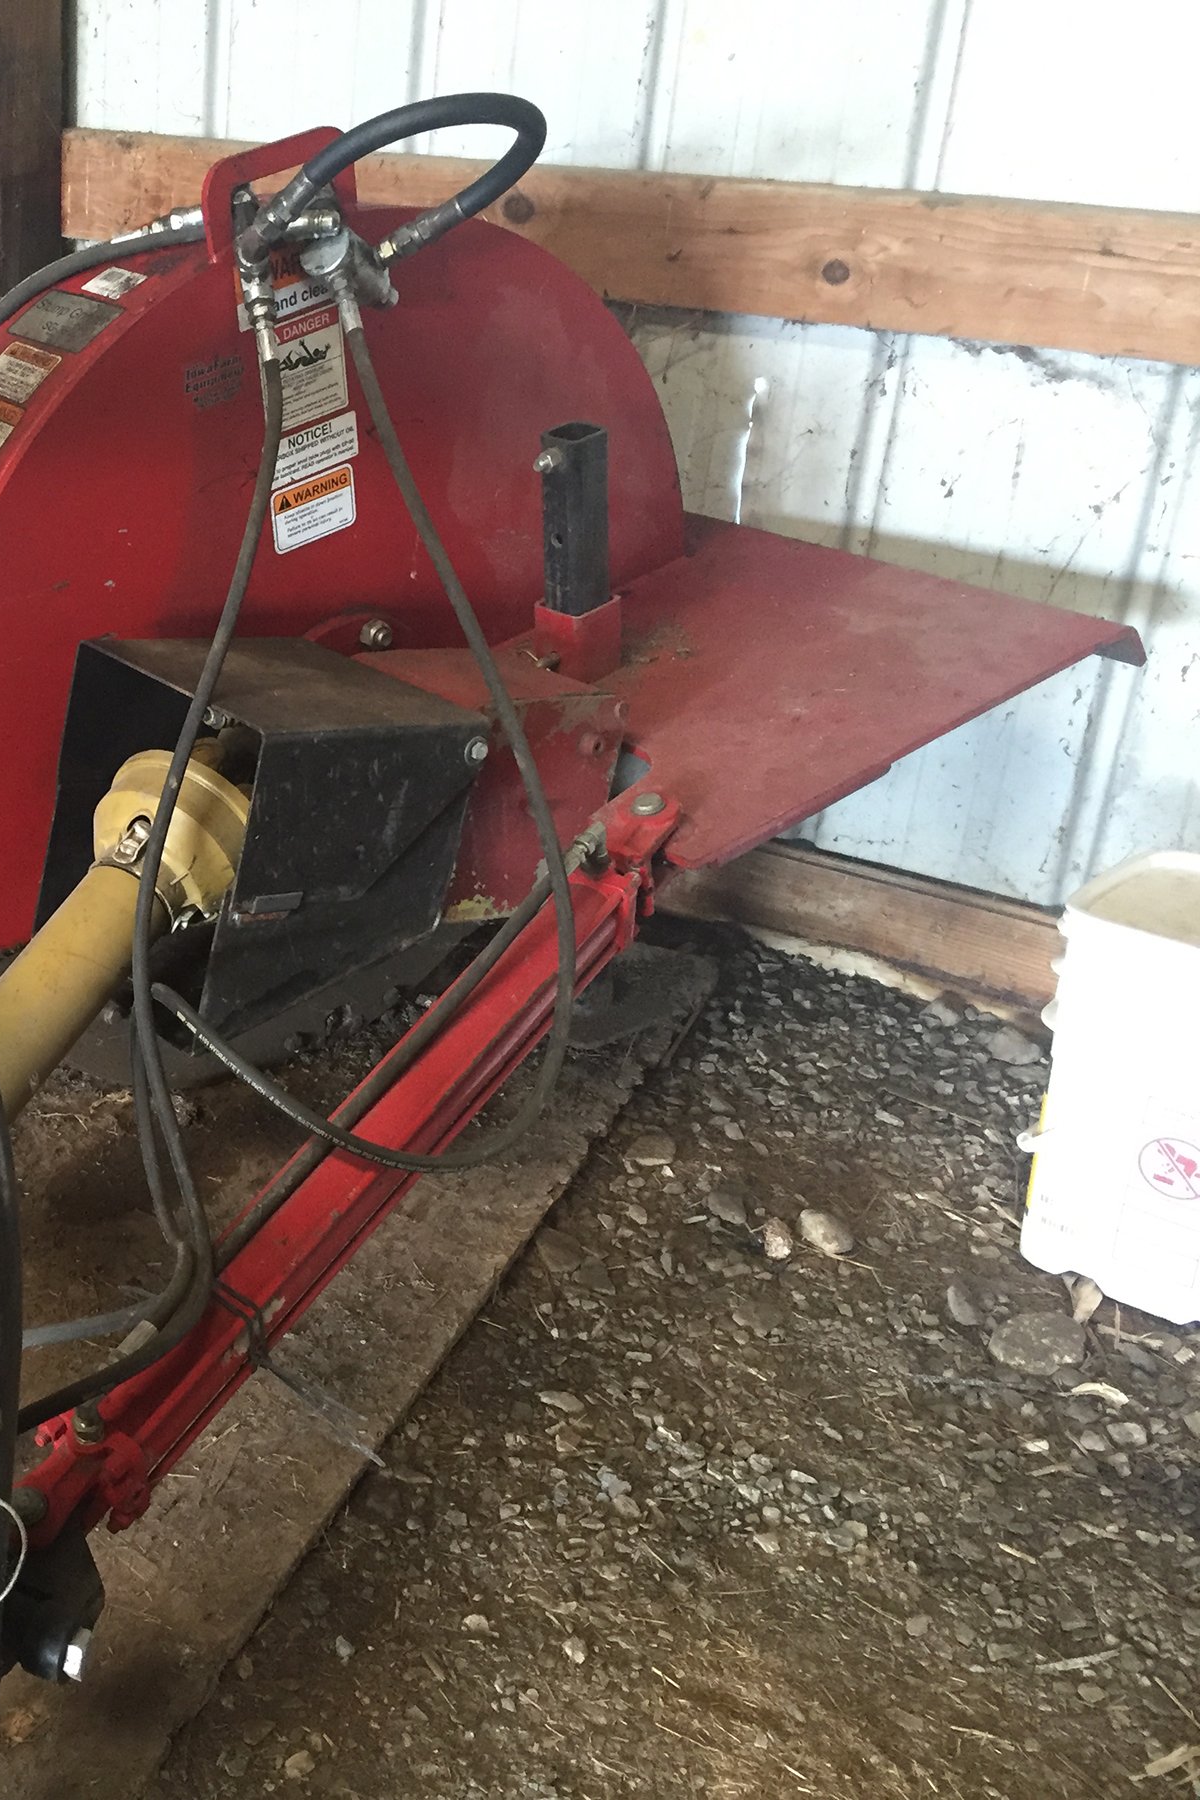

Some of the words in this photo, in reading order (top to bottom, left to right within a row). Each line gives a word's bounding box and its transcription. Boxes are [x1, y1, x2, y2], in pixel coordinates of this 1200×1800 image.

[301, 284, 329, 299] clea
[283, 312, 330, 340] DANGER
[287, 421, 333, 449] NOTICE!
[293, 472, 348, 504] WARNING
